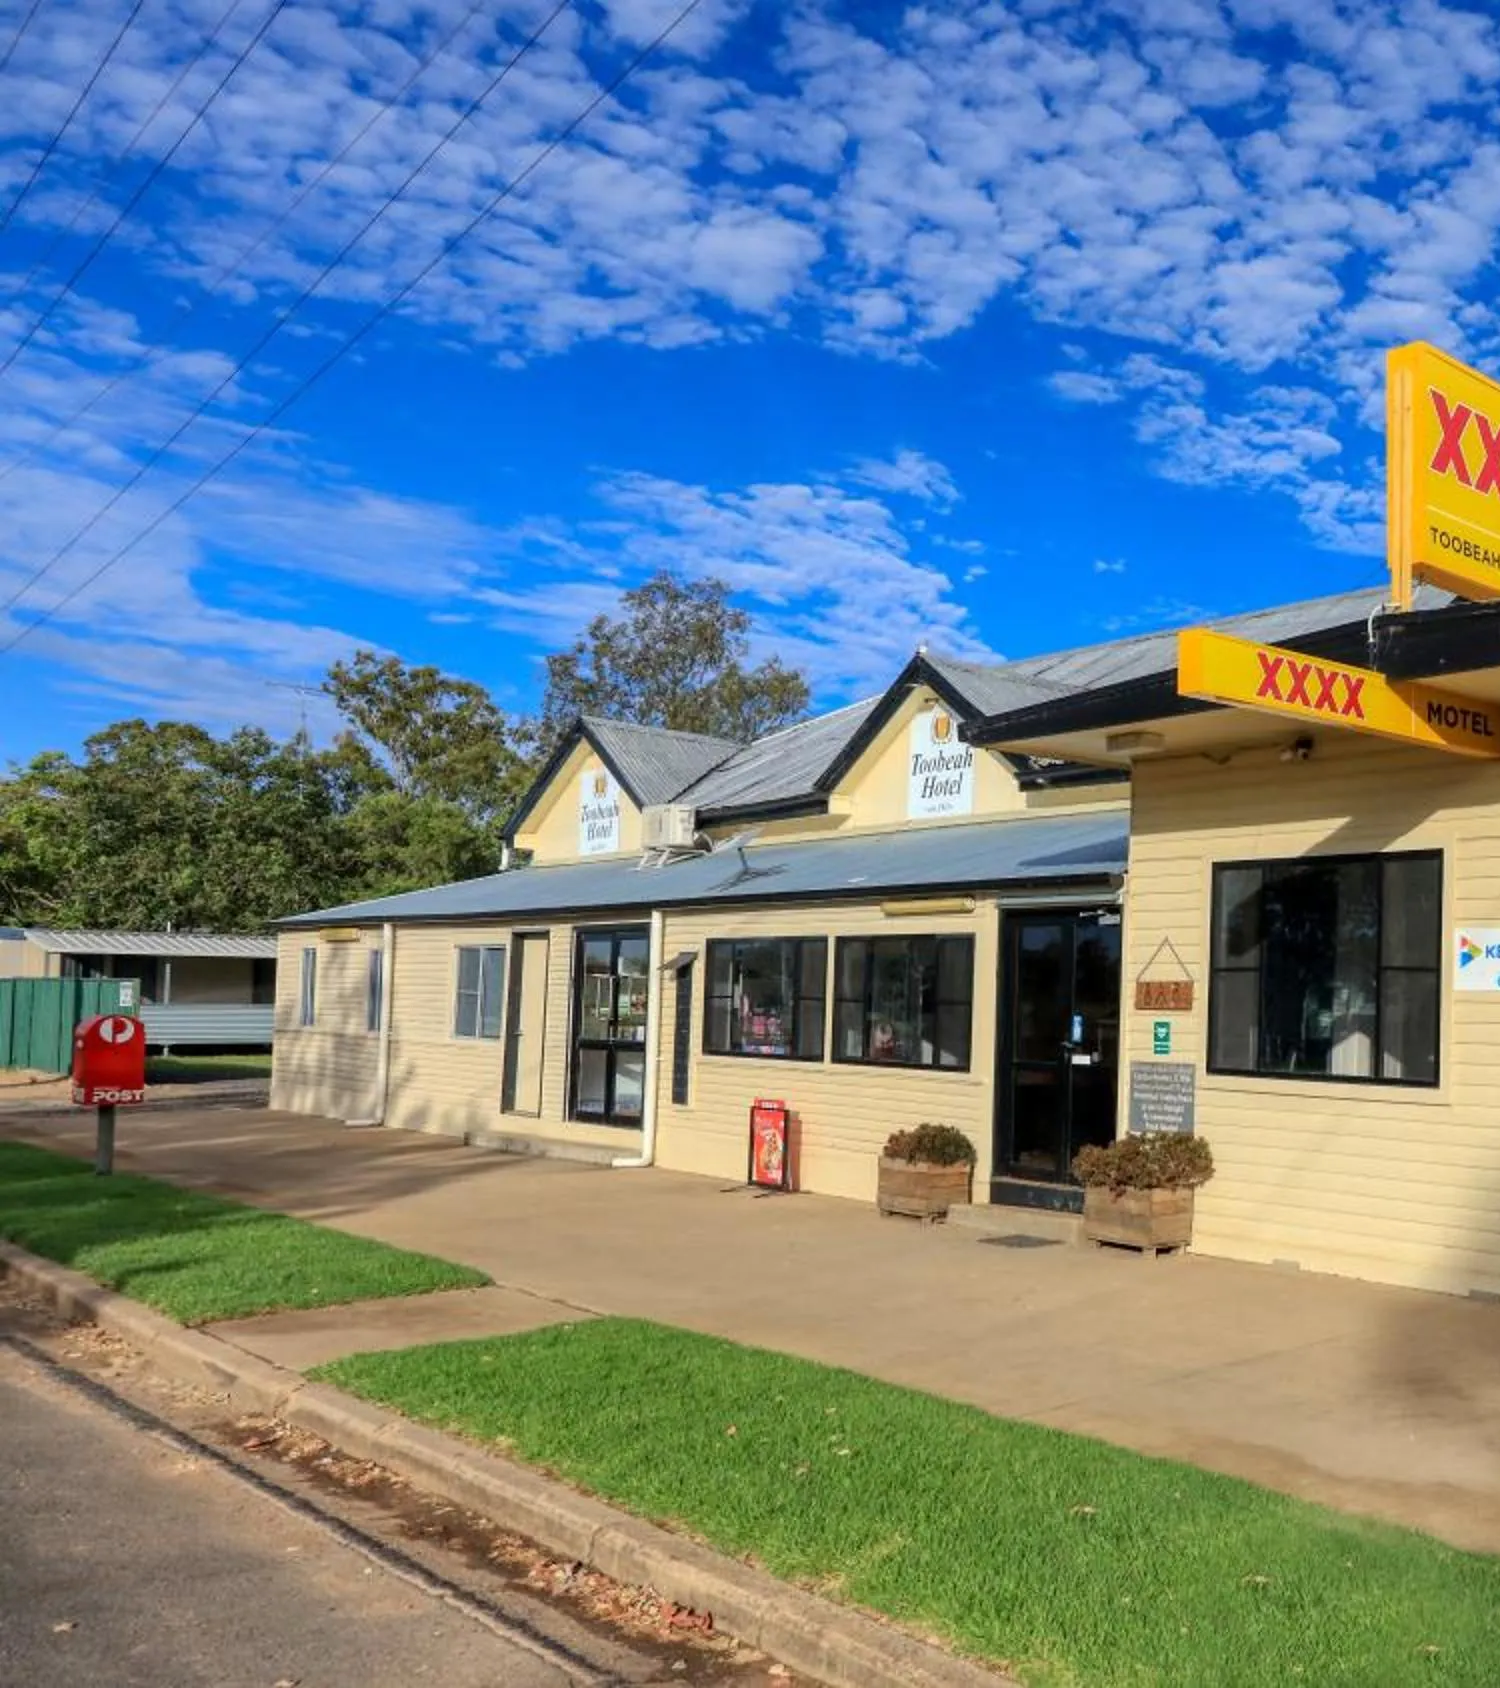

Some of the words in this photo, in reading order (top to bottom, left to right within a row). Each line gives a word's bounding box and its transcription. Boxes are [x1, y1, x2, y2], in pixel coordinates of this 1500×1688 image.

[1430, 526, 1500, 569] TOOBEAH
[1256, 651, 1365, 721] XXXX
[1427, 702, 1495, 737] MOTEL
[911, 746, 973, 776] Toobeah
[921, 771, 964, 799] Hotel
[92, 1089, 144, 1103] POST
